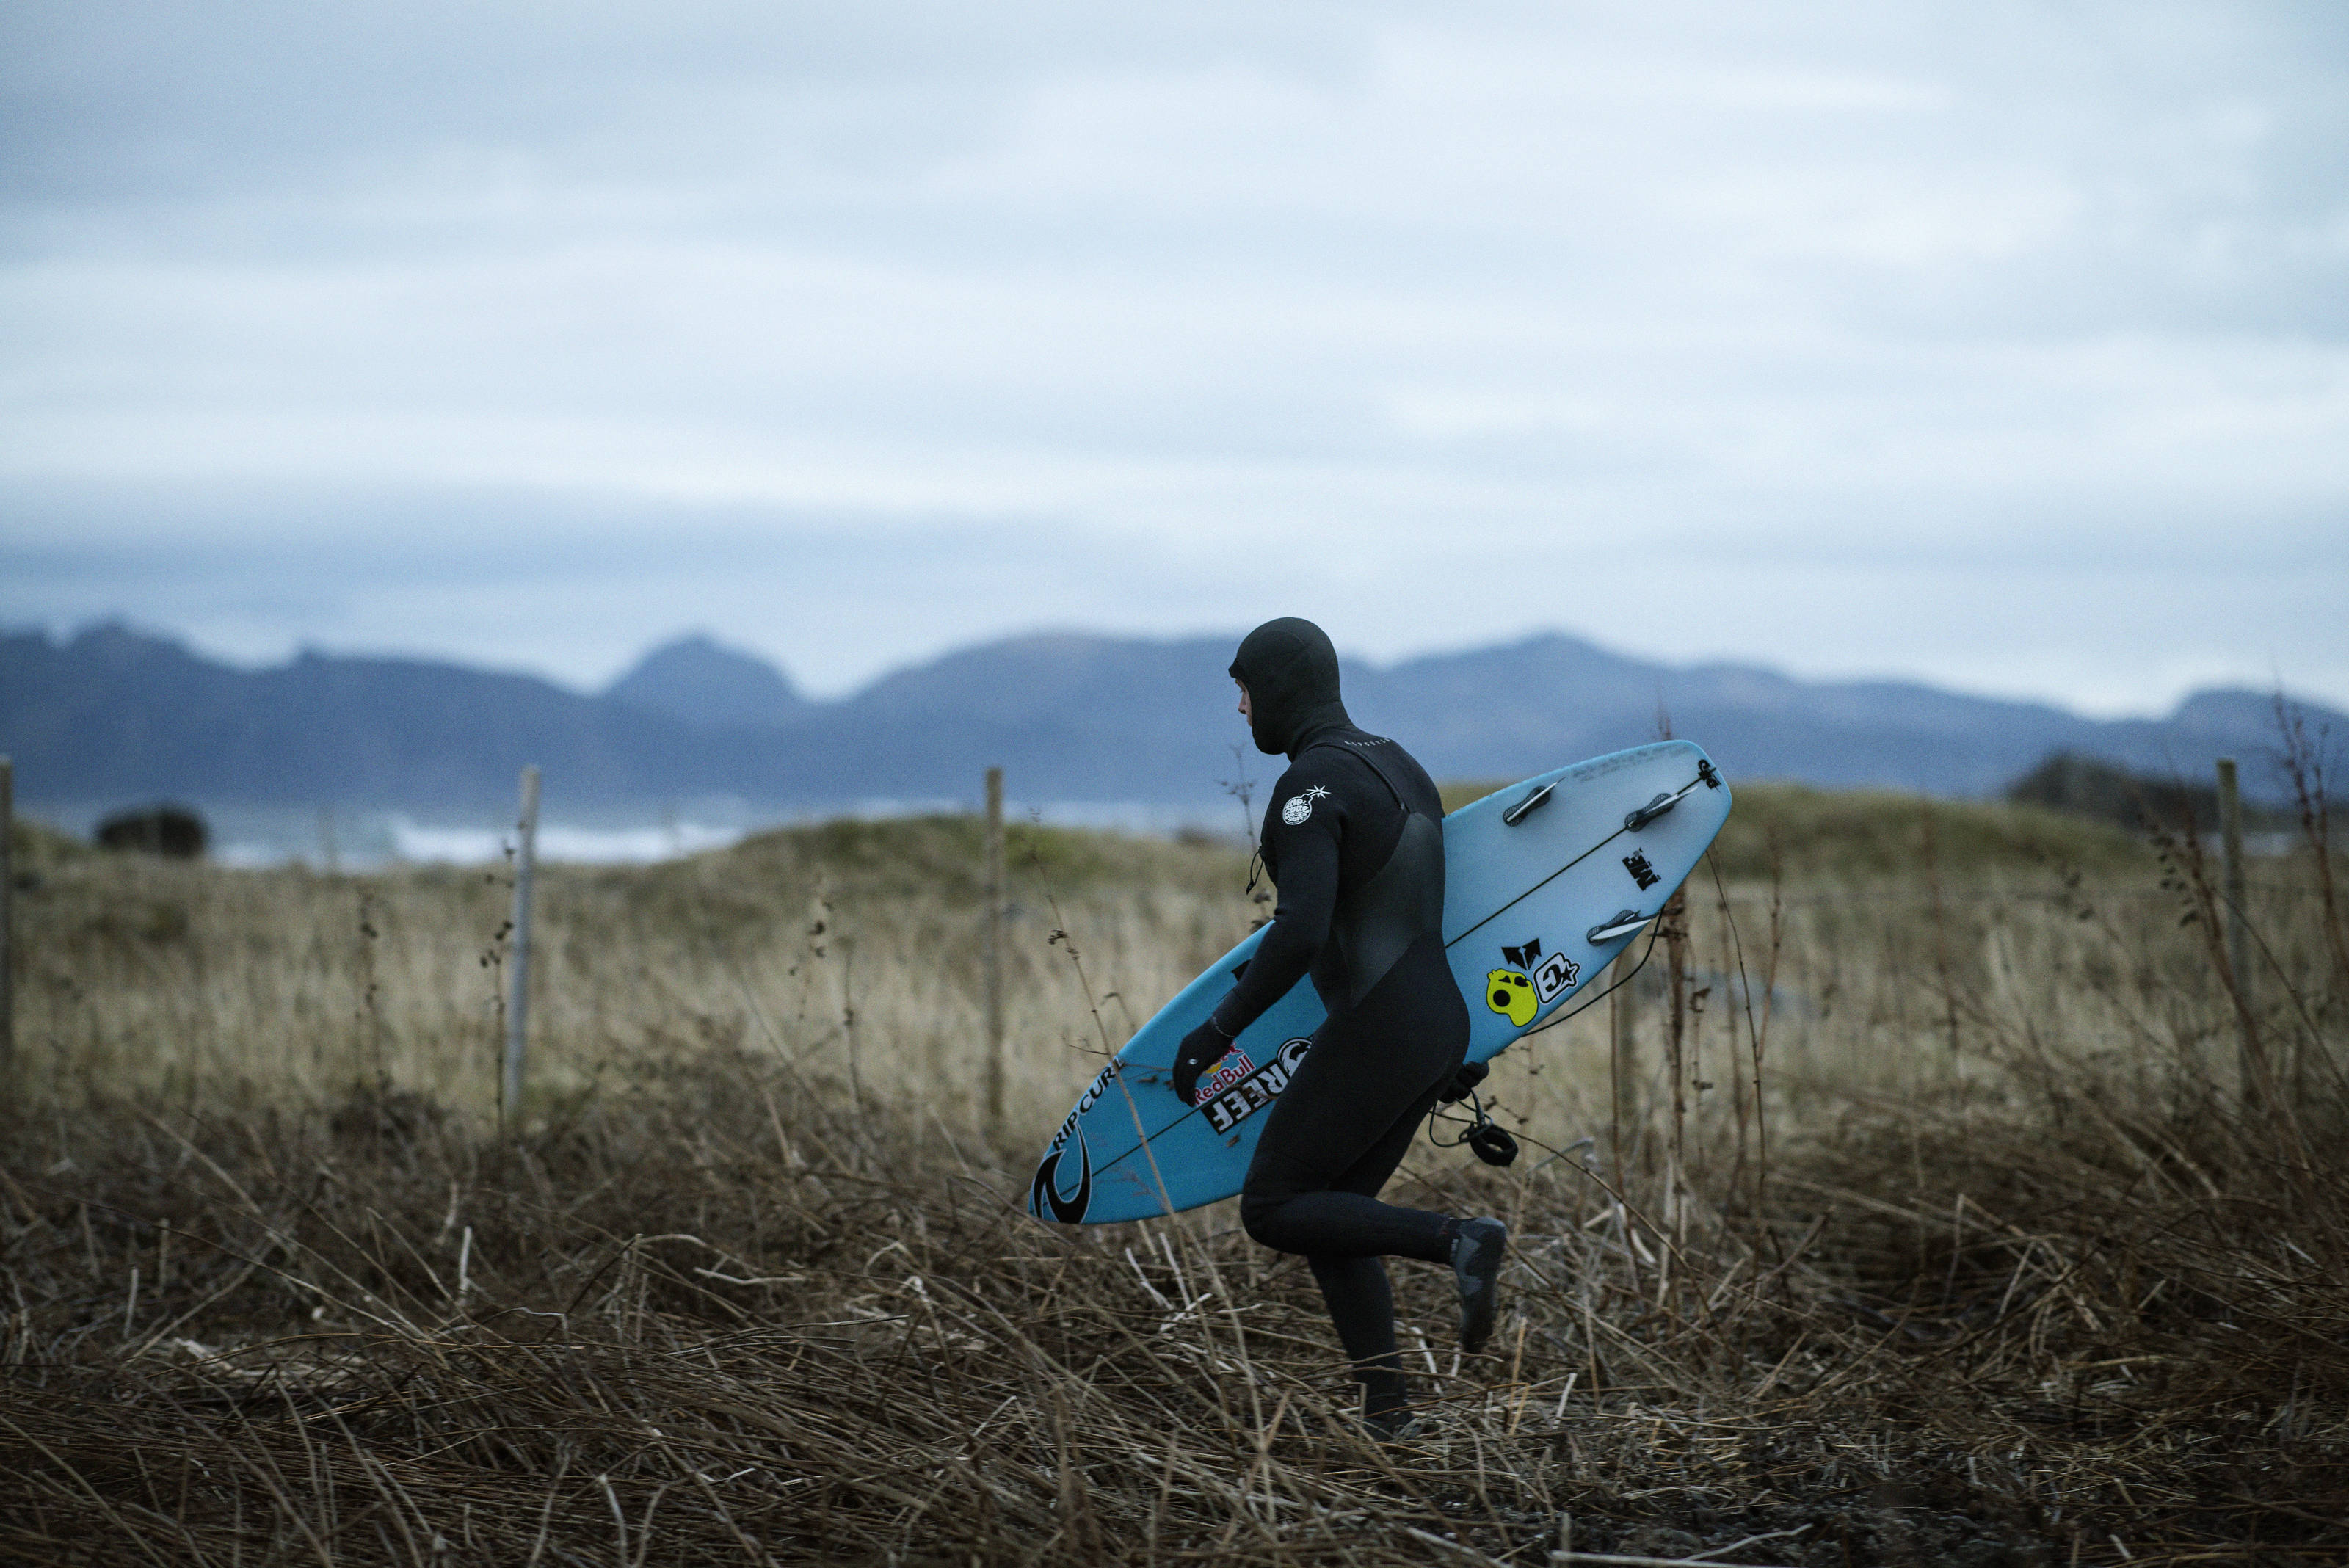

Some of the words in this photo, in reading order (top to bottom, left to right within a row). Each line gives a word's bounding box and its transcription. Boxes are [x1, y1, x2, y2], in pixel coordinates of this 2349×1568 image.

[1053, 1111, 1078, 1150] RIP
[1079, 1059, 1126, 1114] CURL
[1194, 1073, 1225, 1106] Red
[1219, 1053, 1256, 1086] Bull
[1213, 1063, 1289, 1131] REEF
